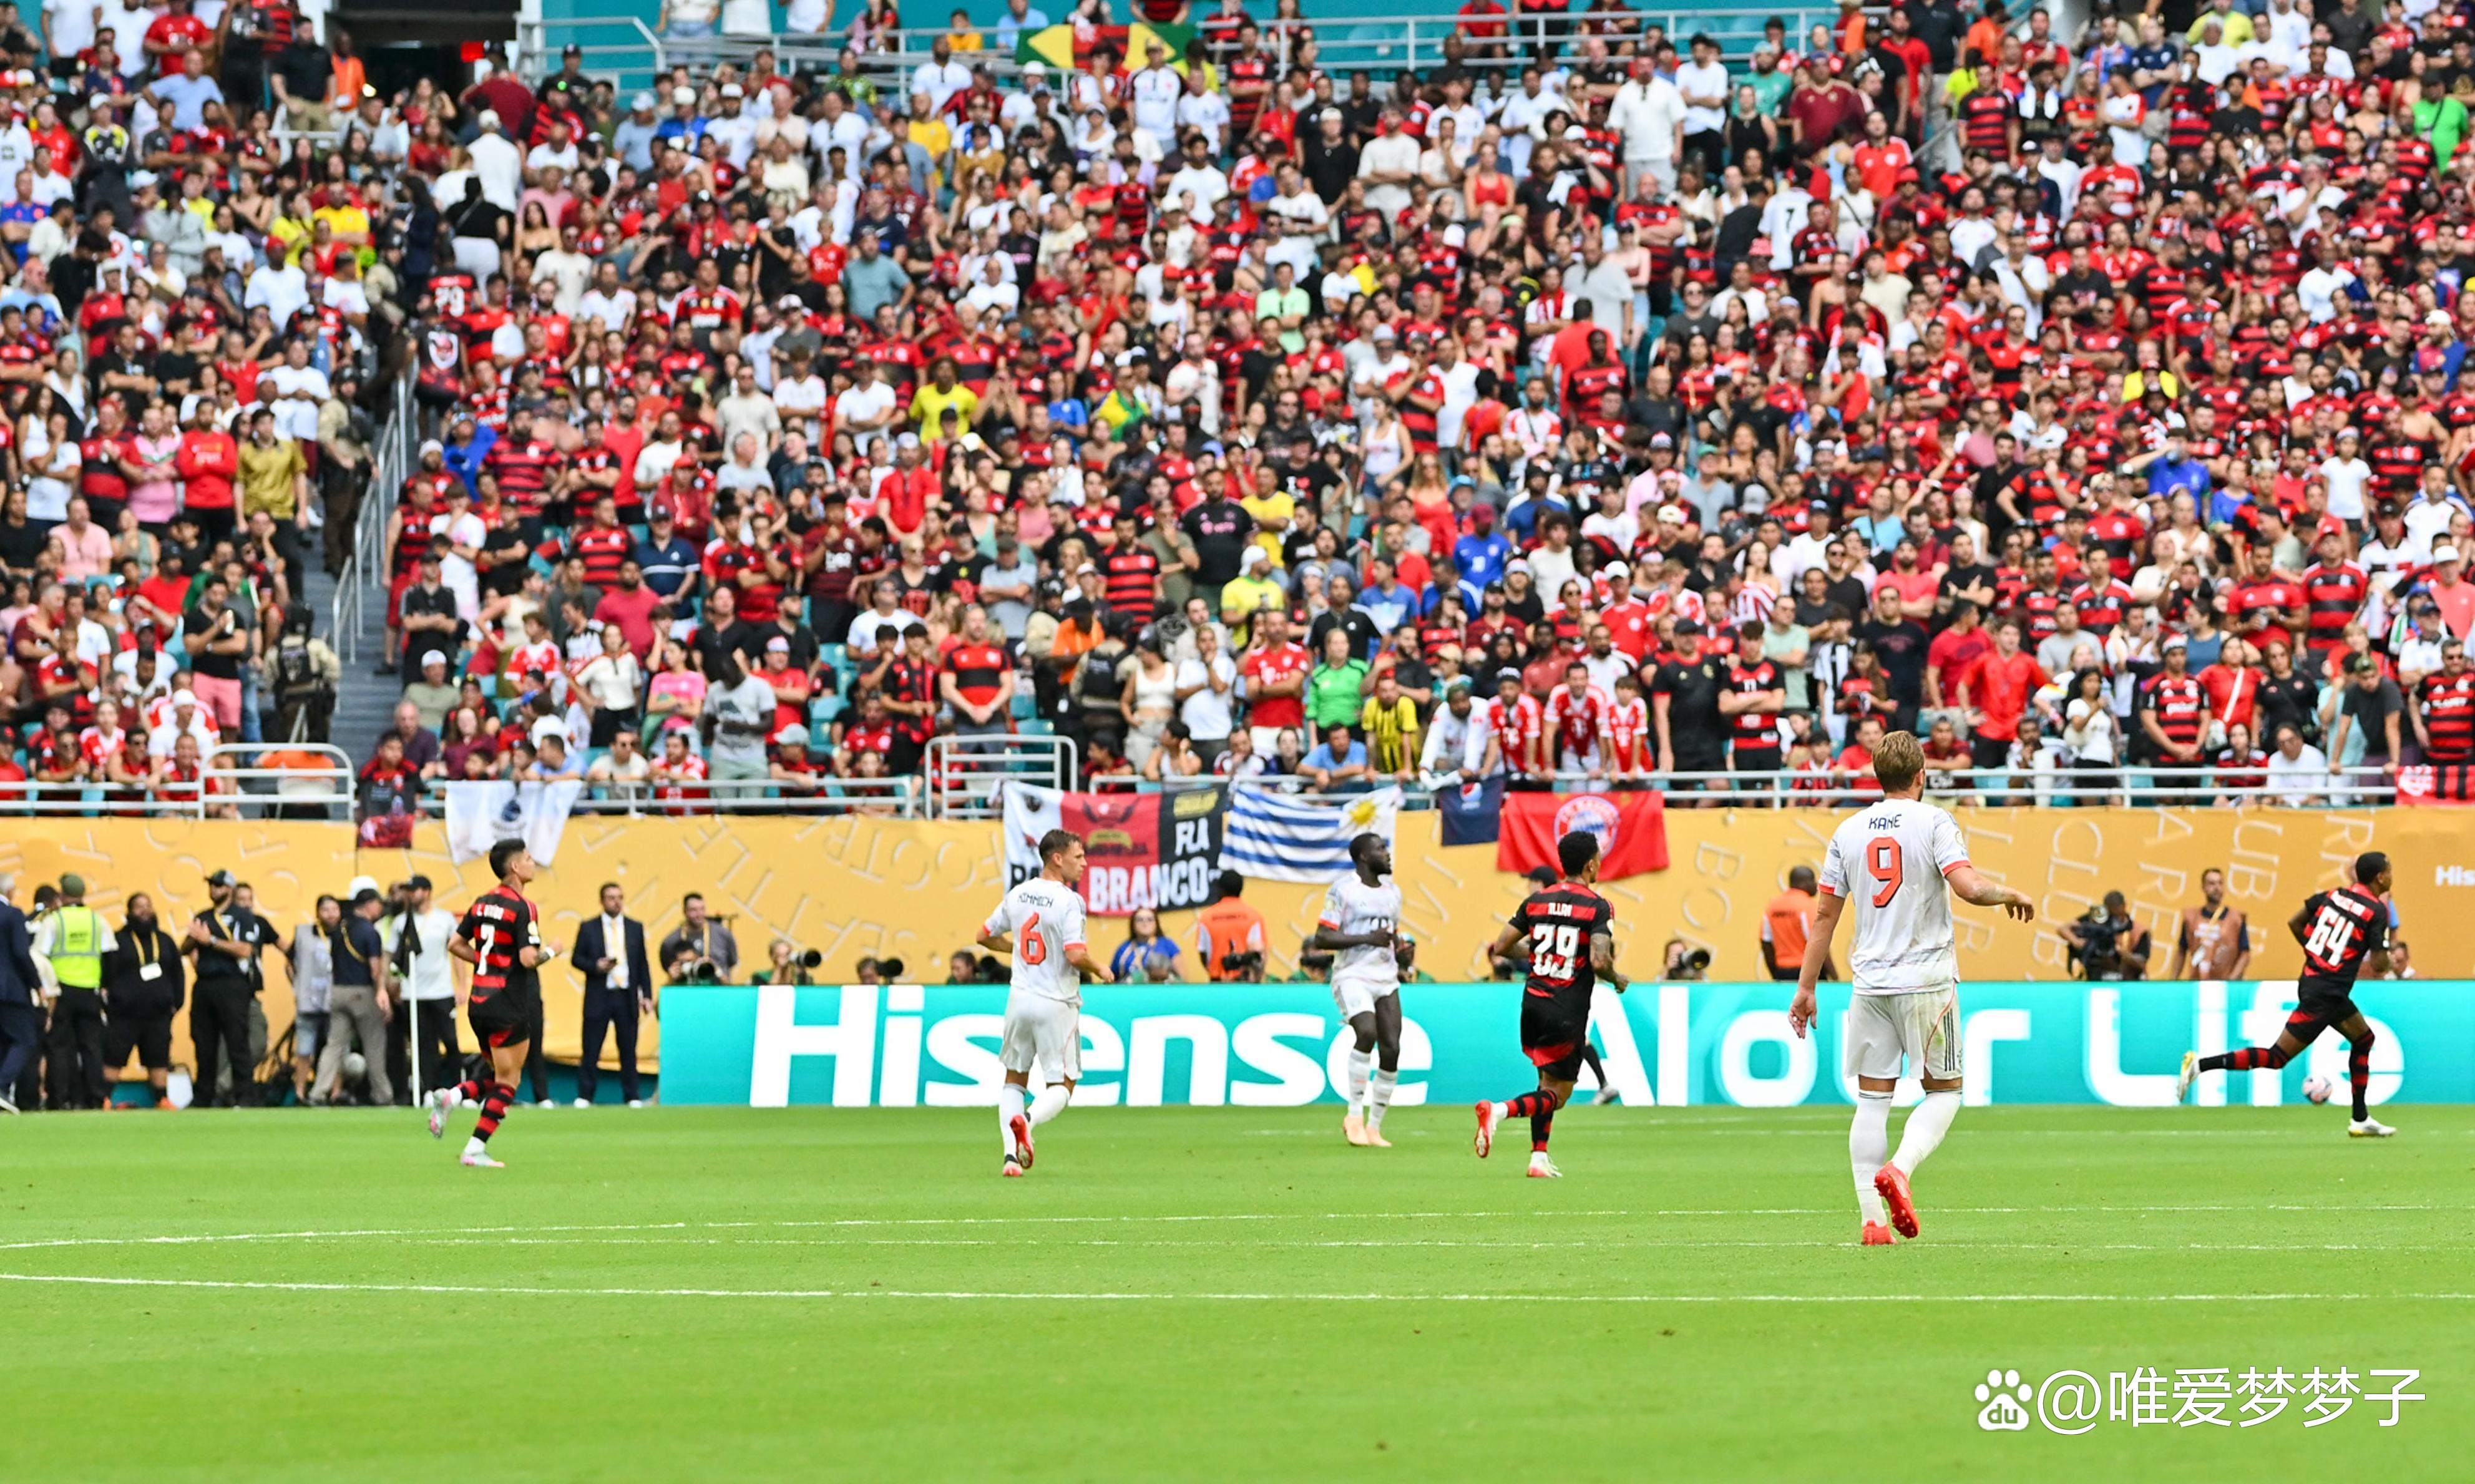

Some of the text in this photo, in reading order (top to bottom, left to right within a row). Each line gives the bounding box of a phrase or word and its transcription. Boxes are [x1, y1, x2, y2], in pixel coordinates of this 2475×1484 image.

[1868, 813, 1902, 831] KANE
[1088, 856, 1211, 914] BRANCO
[1866, 836, 1903, 909] 9
[476, 922, 495, 976] 7
[1020, 911, 1047, 965] 6
[1533, 922, 1581, 980] 29
[2305, 905, 2355, 967] 64
